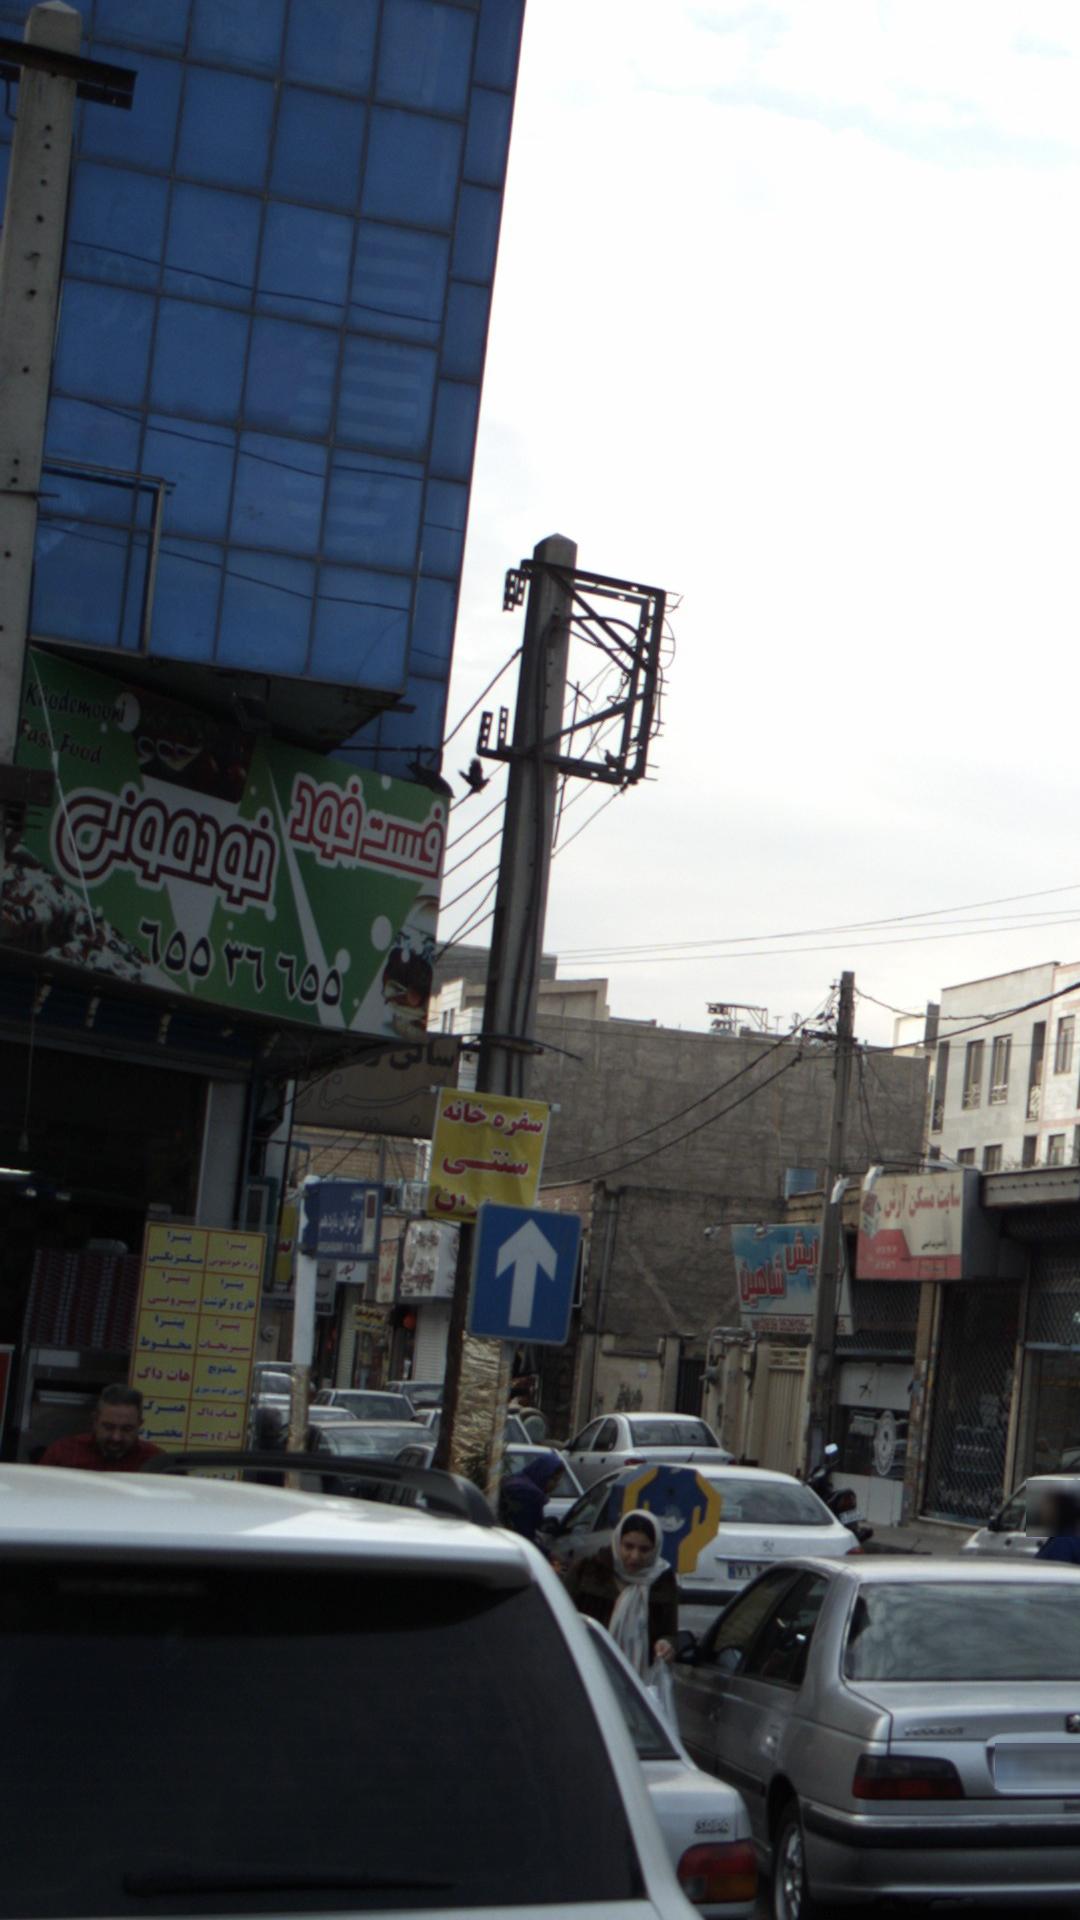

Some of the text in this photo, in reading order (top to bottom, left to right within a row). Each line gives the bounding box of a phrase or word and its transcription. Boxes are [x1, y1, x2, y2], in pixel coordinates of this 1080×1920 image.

[55, 790, 278, 904] خودمونی
[289, 778, 445, 880] فست فود
[442, 1100, 544, 1137] سفره خانه
[442, 1149, 529, 1175] سنتی
